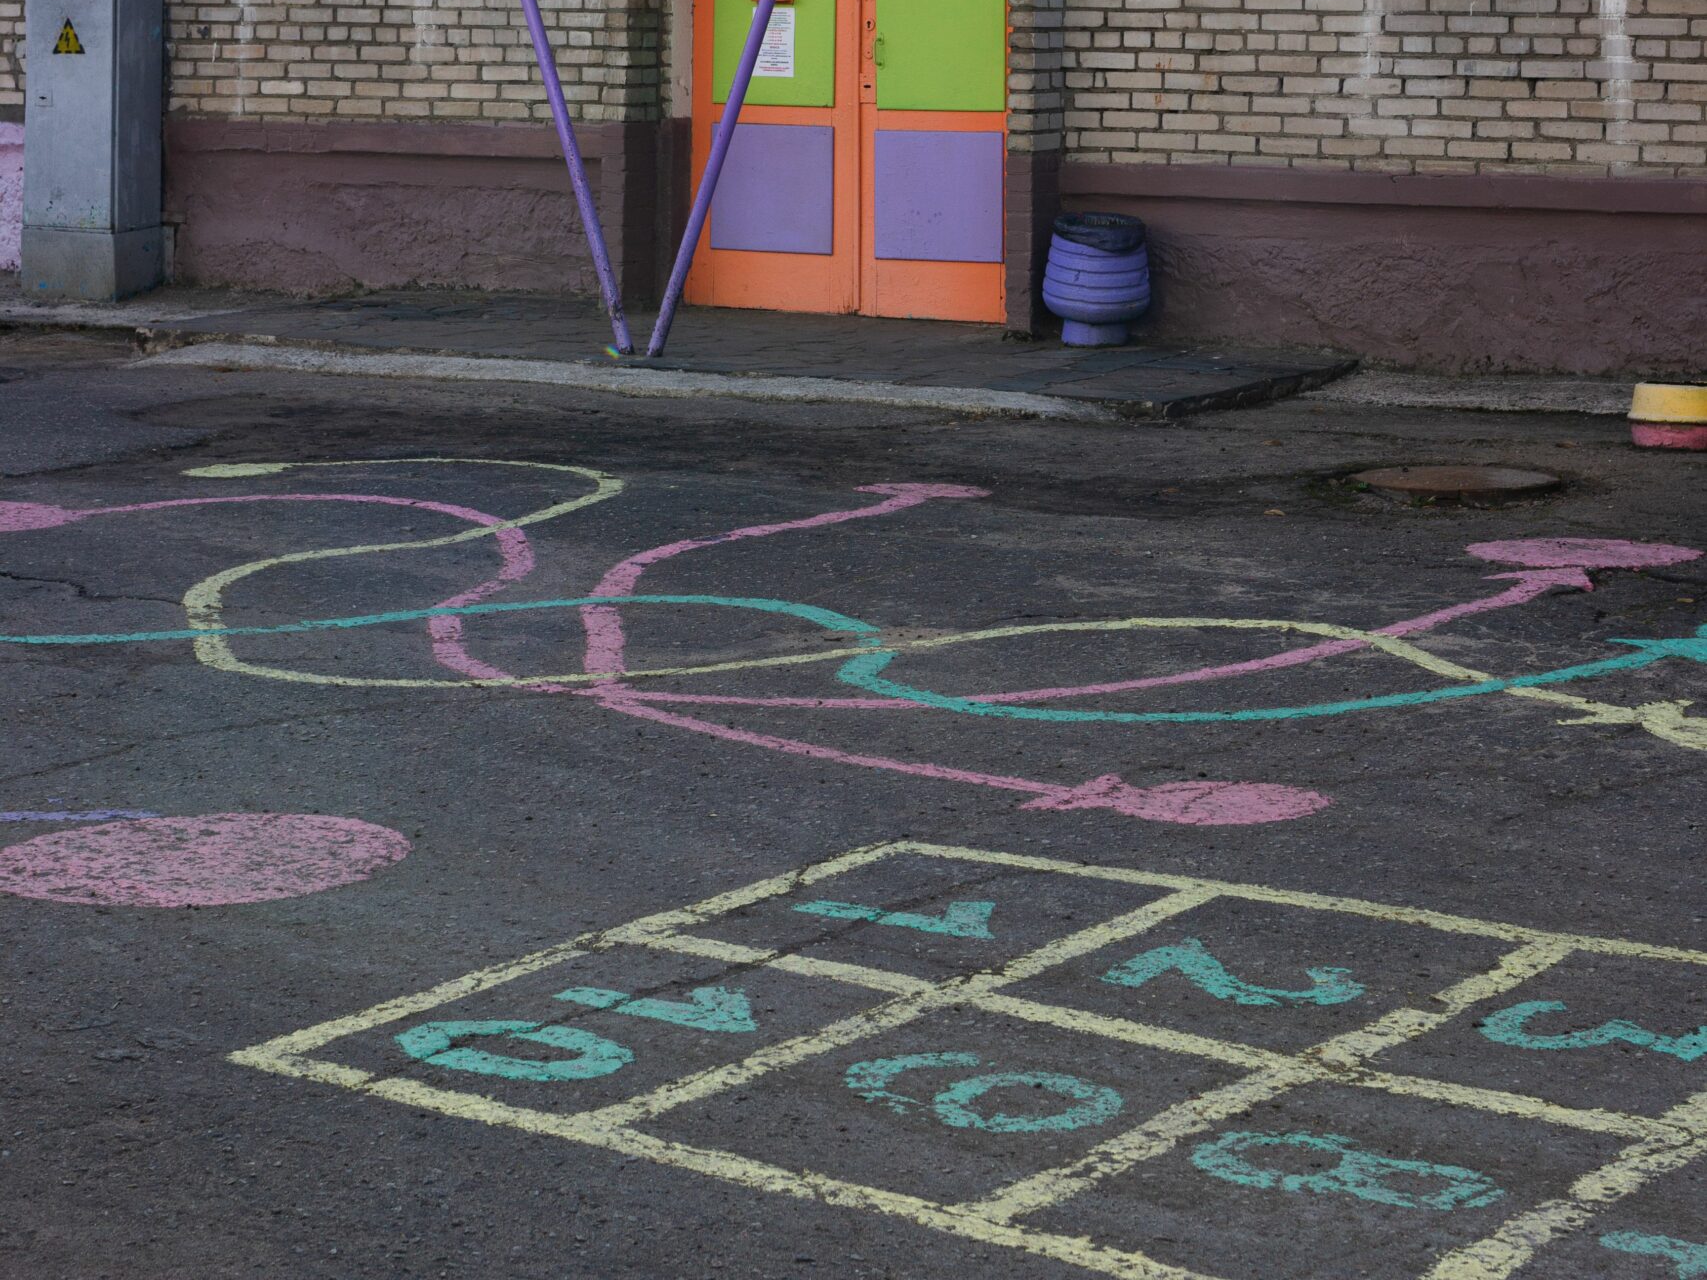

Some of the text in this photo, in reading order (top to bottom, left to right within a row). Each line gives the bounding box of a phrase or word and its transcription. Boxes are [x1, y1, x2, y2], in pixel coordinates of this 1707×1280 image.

[1100, 938, 1366, 1007] 2
[394, 985, 758, 1082] 10
[1192, 1131, 1506, 1211] 8
